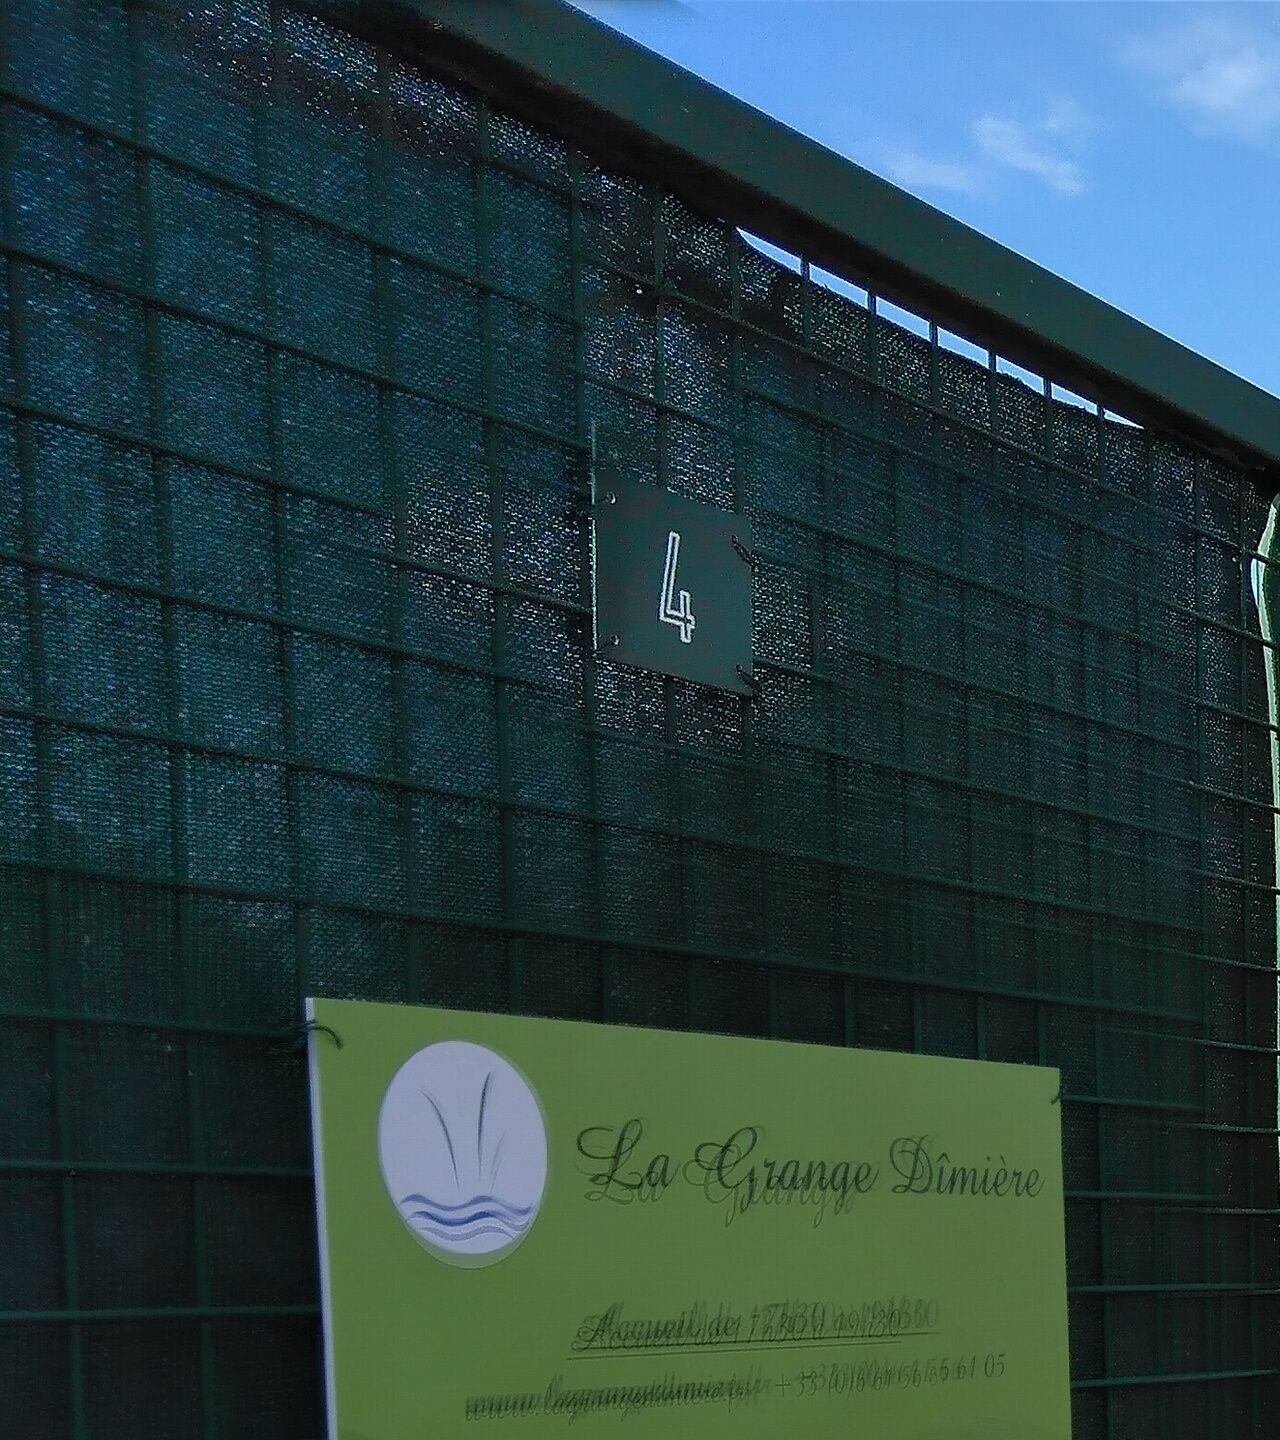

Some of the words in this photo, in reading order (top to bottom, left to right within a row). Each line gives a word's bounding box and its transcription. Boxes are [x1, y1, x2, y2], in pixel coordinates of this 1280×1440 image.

[659, 530, 696, 643] 4
[577, 1117, 681, 1204] La
[688, 1126, 880, 1224] Grange
[889, 1133, 1046, 1199] Dîmière
